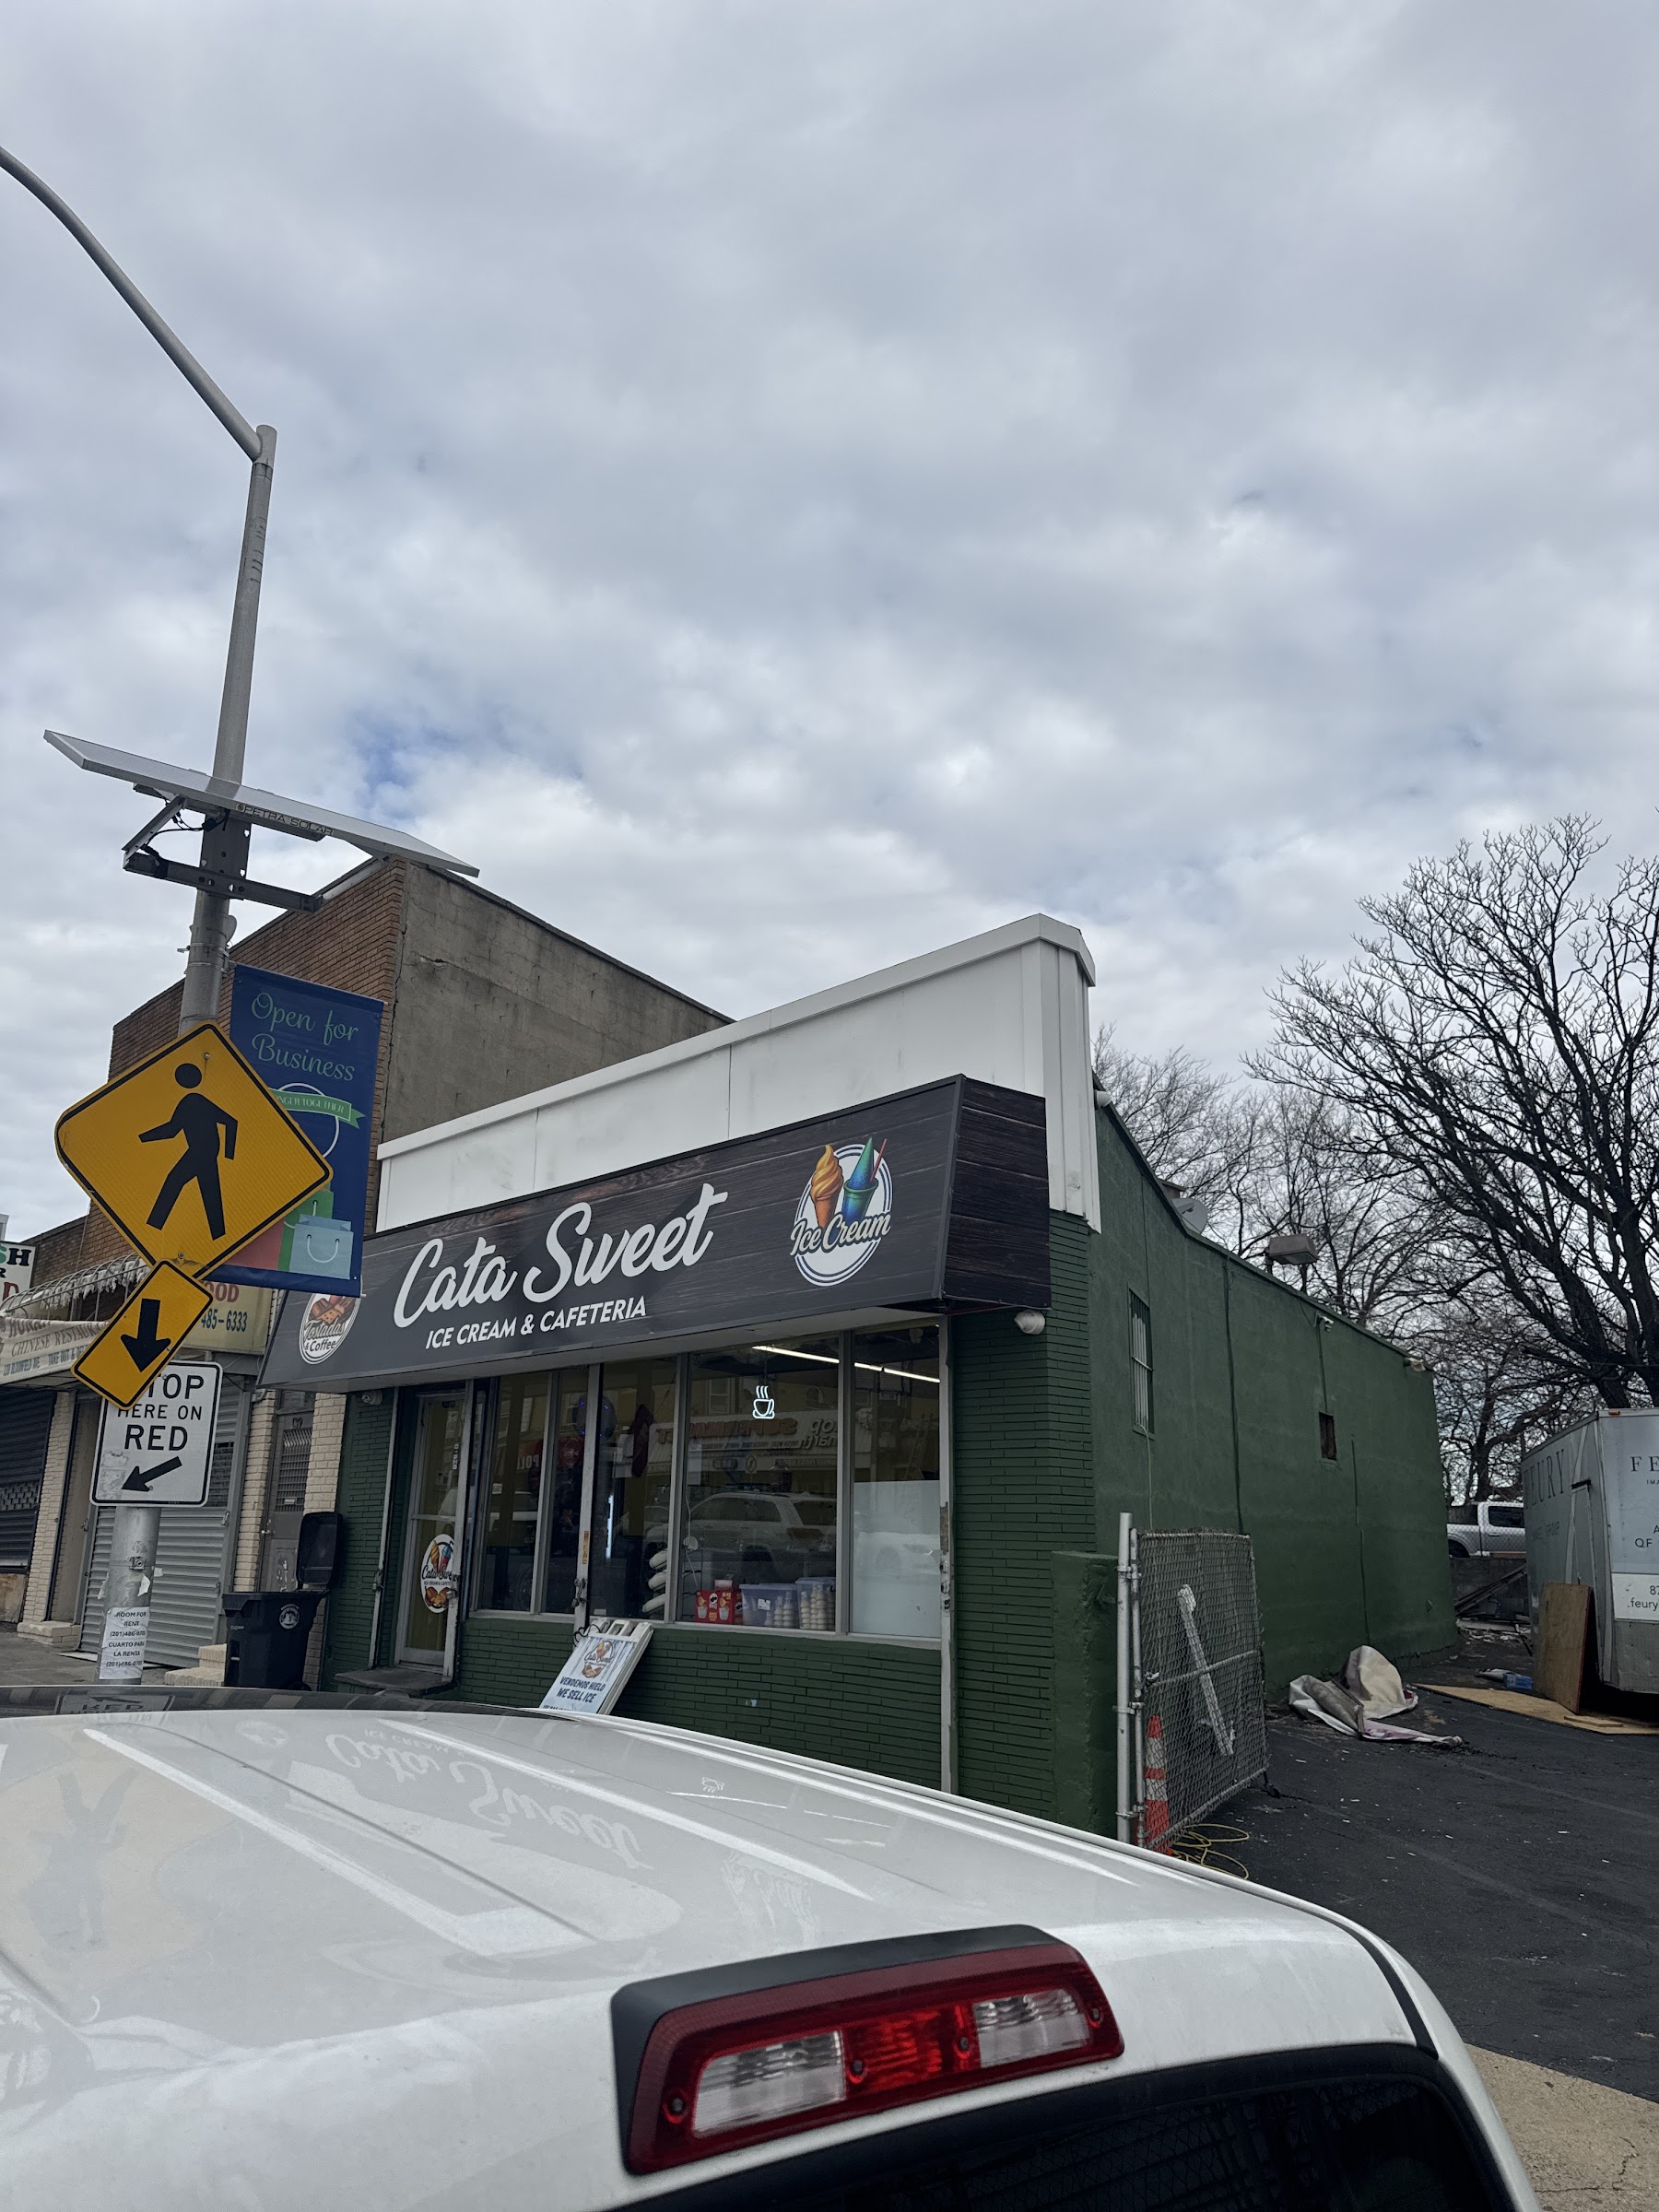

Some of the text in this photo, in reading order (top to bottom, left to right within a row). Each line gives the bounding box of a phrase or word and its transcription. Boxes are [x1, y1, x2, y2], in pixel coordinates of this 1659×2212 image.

[244, 806, 333, 836] PETRA SOLAR
[252, 993, 359, 1045] Open for
[252, 1033, 355, 1080] Business
[790, 1212, 891, 1255] Ice Cream
[394, 1183, 728, 1328] Cata Sweet
[304, 1317, 347, 1342] Tostadas
[426, 1296, 647, 1349] ICE CREAM & CAFETERIA
[11, 1335, 50, 1358] CHINESE
[310, 1338, 336, 1352] Coffee
[148, 1373, 205, 1399] TOP
[117, 1403, 202, 1420] HERE ON
[124, 1424, 188, 1451] RED
[557, 1688, 597, 1703] WE SELL ICE
[559, 1677, 606, 1692] VENDEMOS HIELO
